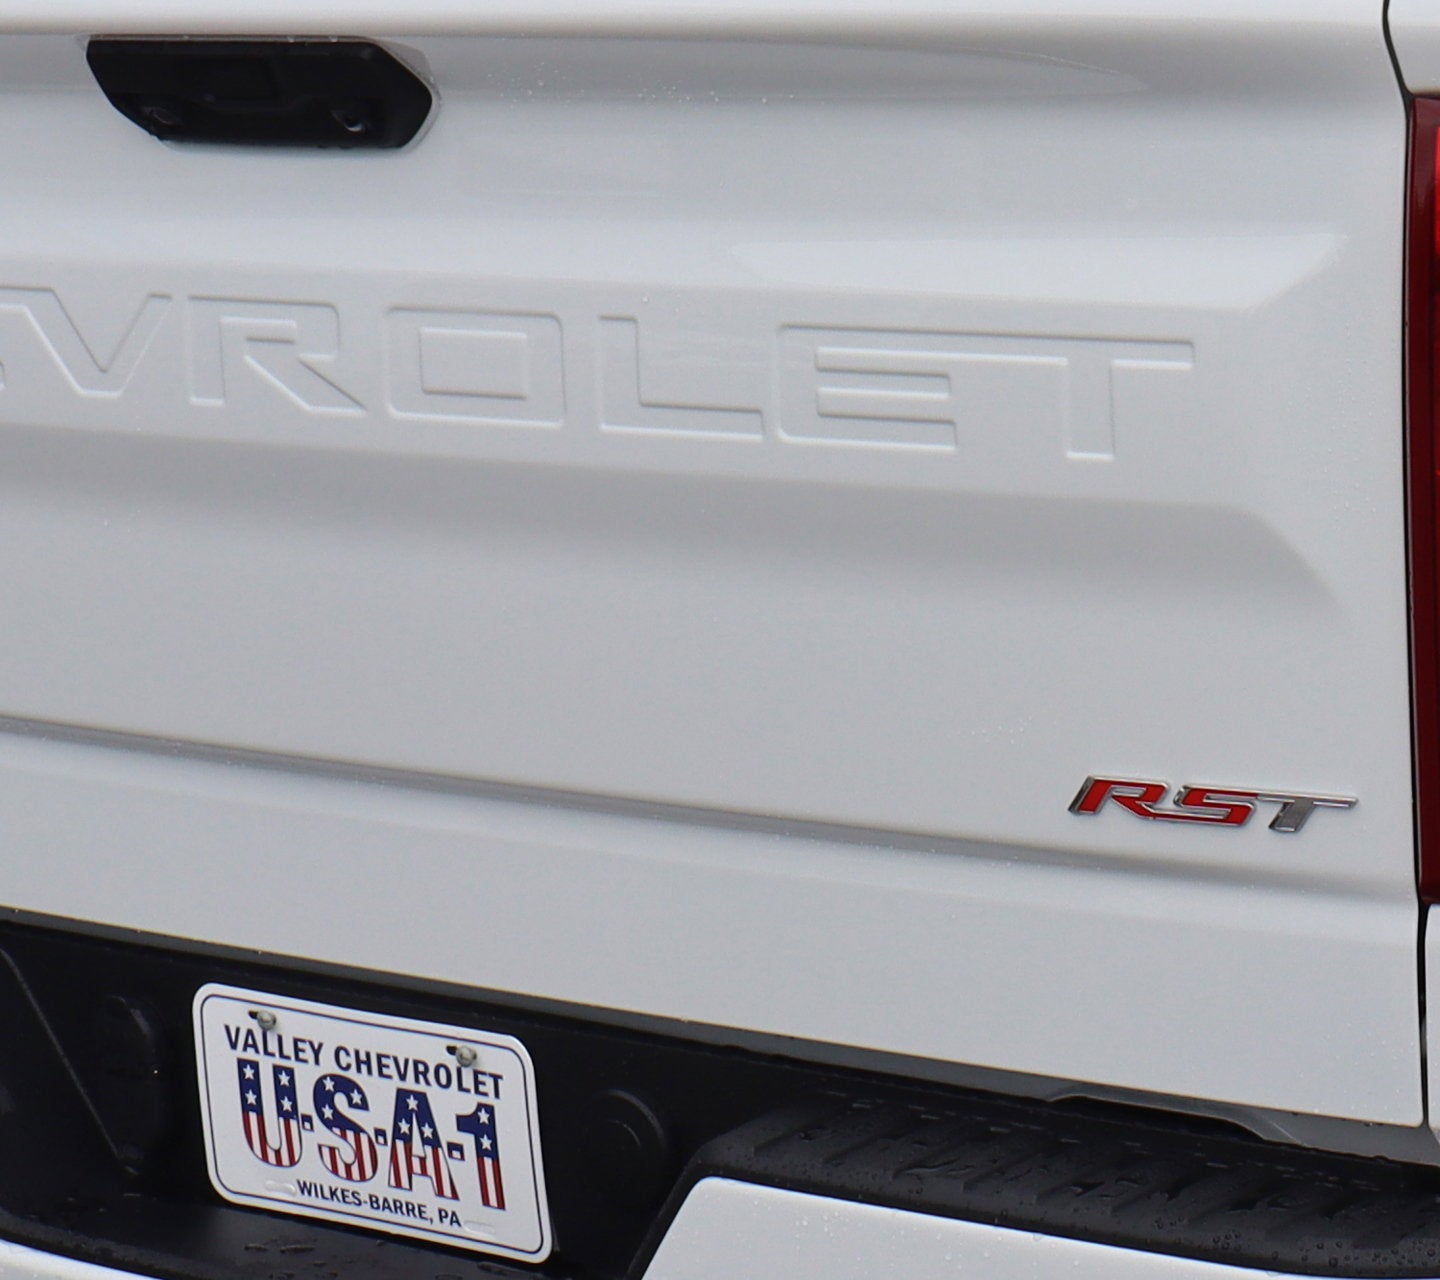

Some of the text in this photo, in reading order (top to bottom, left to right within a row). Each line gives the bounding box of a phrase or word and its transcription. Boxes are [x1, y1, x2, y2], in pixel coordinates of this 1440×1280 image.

[1067, 774, 1359, 833] RST
[223, 1023, 505, 1100] VALLEY CHEVROLET
[295, 1178, 463, 1229] WILKES-BARRE, PA
